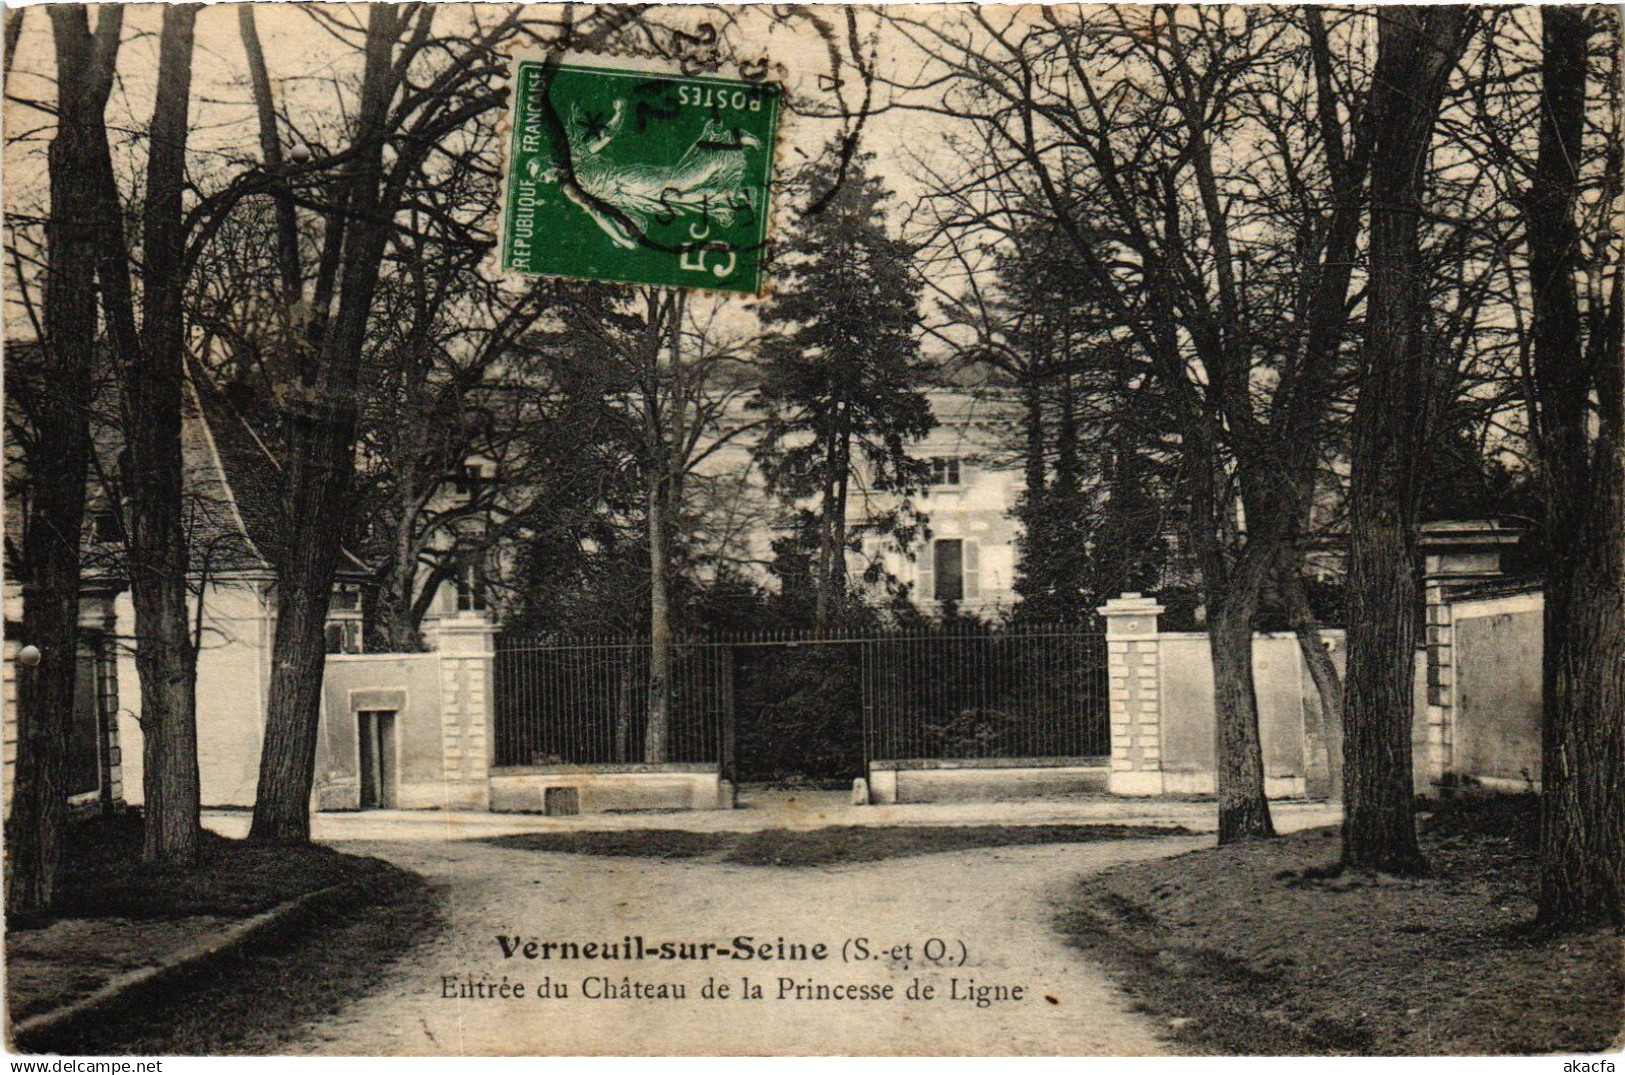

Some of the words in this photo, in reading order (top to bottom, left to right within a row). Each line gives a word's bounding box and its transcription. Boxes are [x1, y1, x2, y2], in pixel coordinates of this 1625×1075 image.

[678, 85, 763, 113] POSTES
[496, 935, 829, 961] Verneuil-sur-Seine
[440, 975, 525, 1000] Entrée
[537, 976, 569, 999] du
[582, 975, 686, 1000] Château
[701, 977, 731, 999] de
[741, 977, 764, 1000] la
[777, 977, 894, 1000] Princesse
[906, 978, 935, 1000] de
[951, 978, 1025, 1009] Ligne
